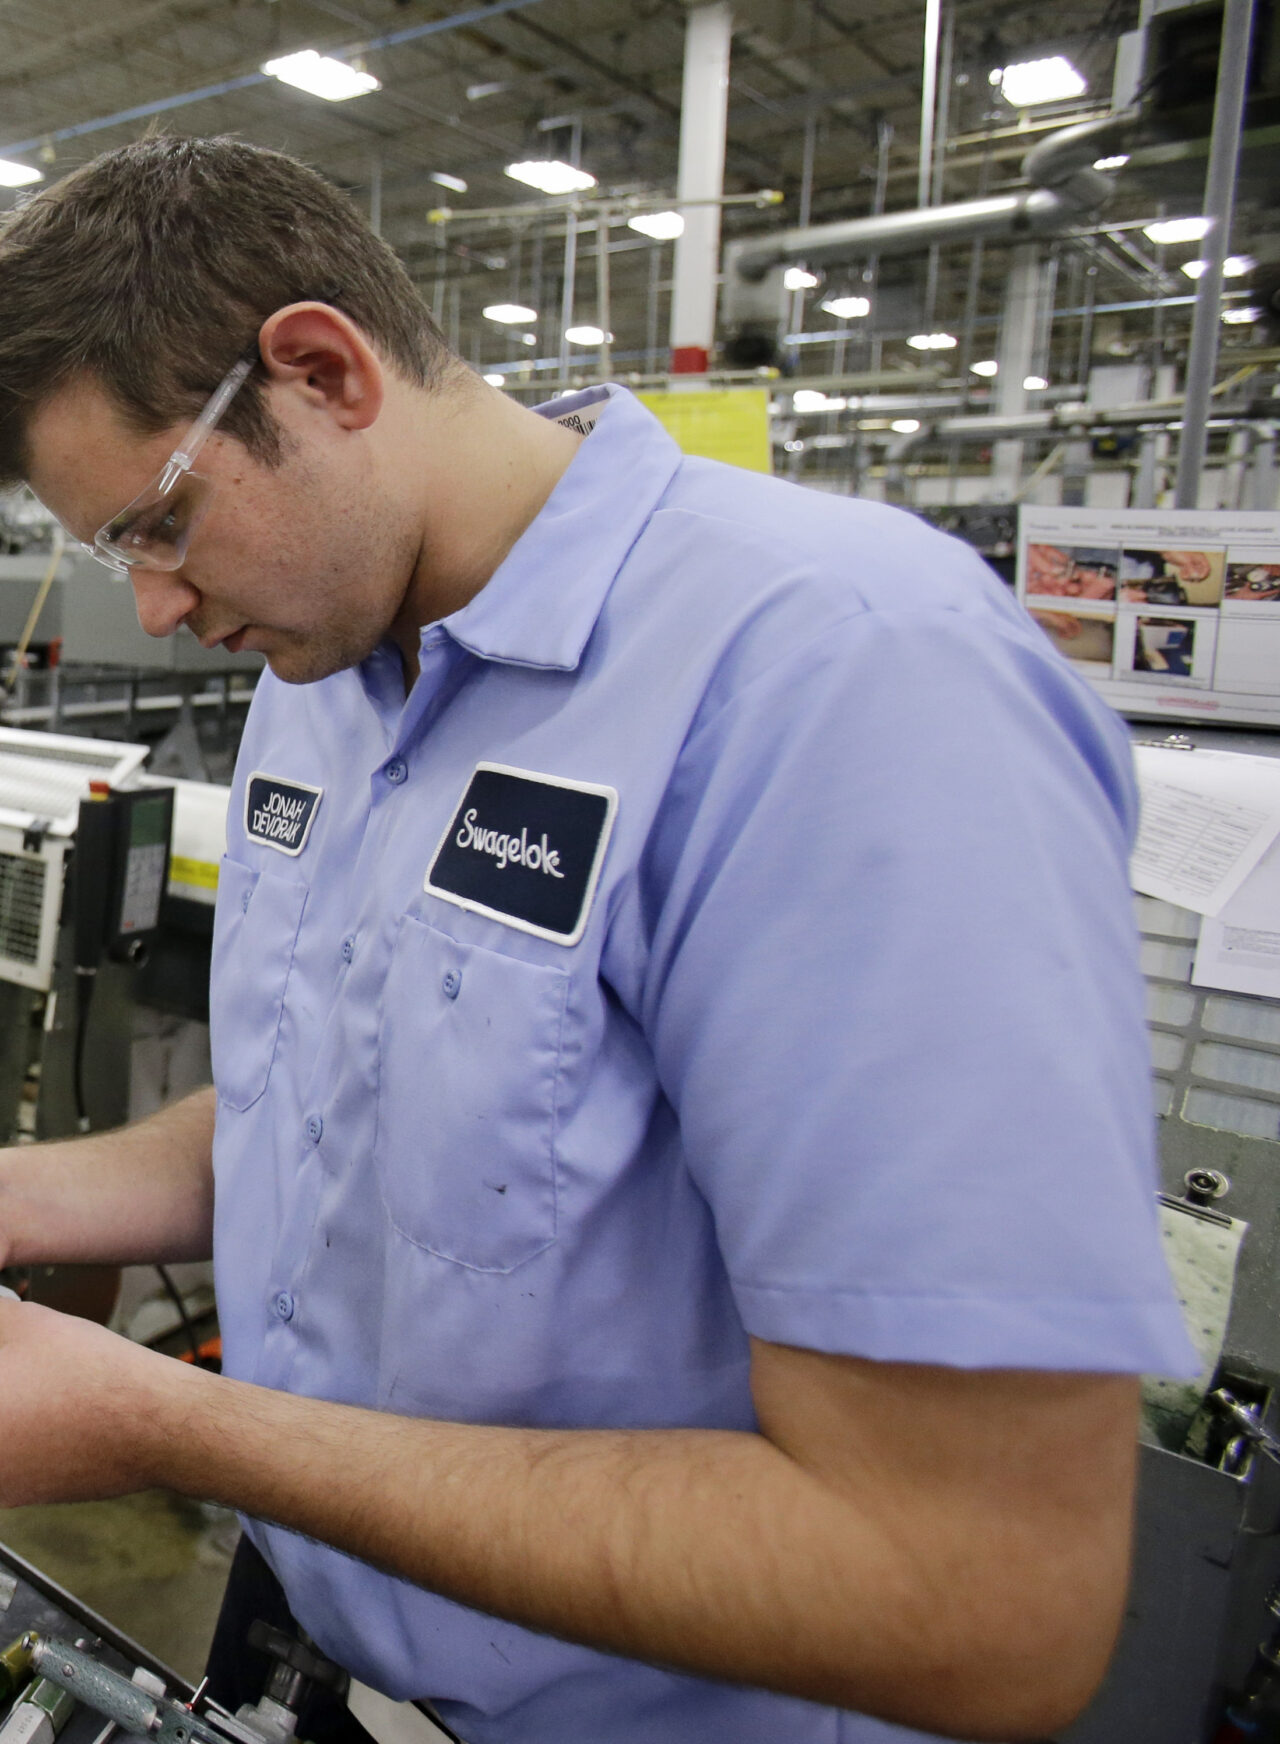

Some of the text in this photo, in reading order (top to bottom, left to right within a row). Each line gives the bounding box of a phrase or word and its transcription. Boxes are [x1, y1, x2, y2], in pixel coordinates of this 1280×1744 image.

[262, 791, 307, 821] JONAH
[252, 809, 301, 843] DEVORAK
[456, 808, 564, 878] Swagelok
